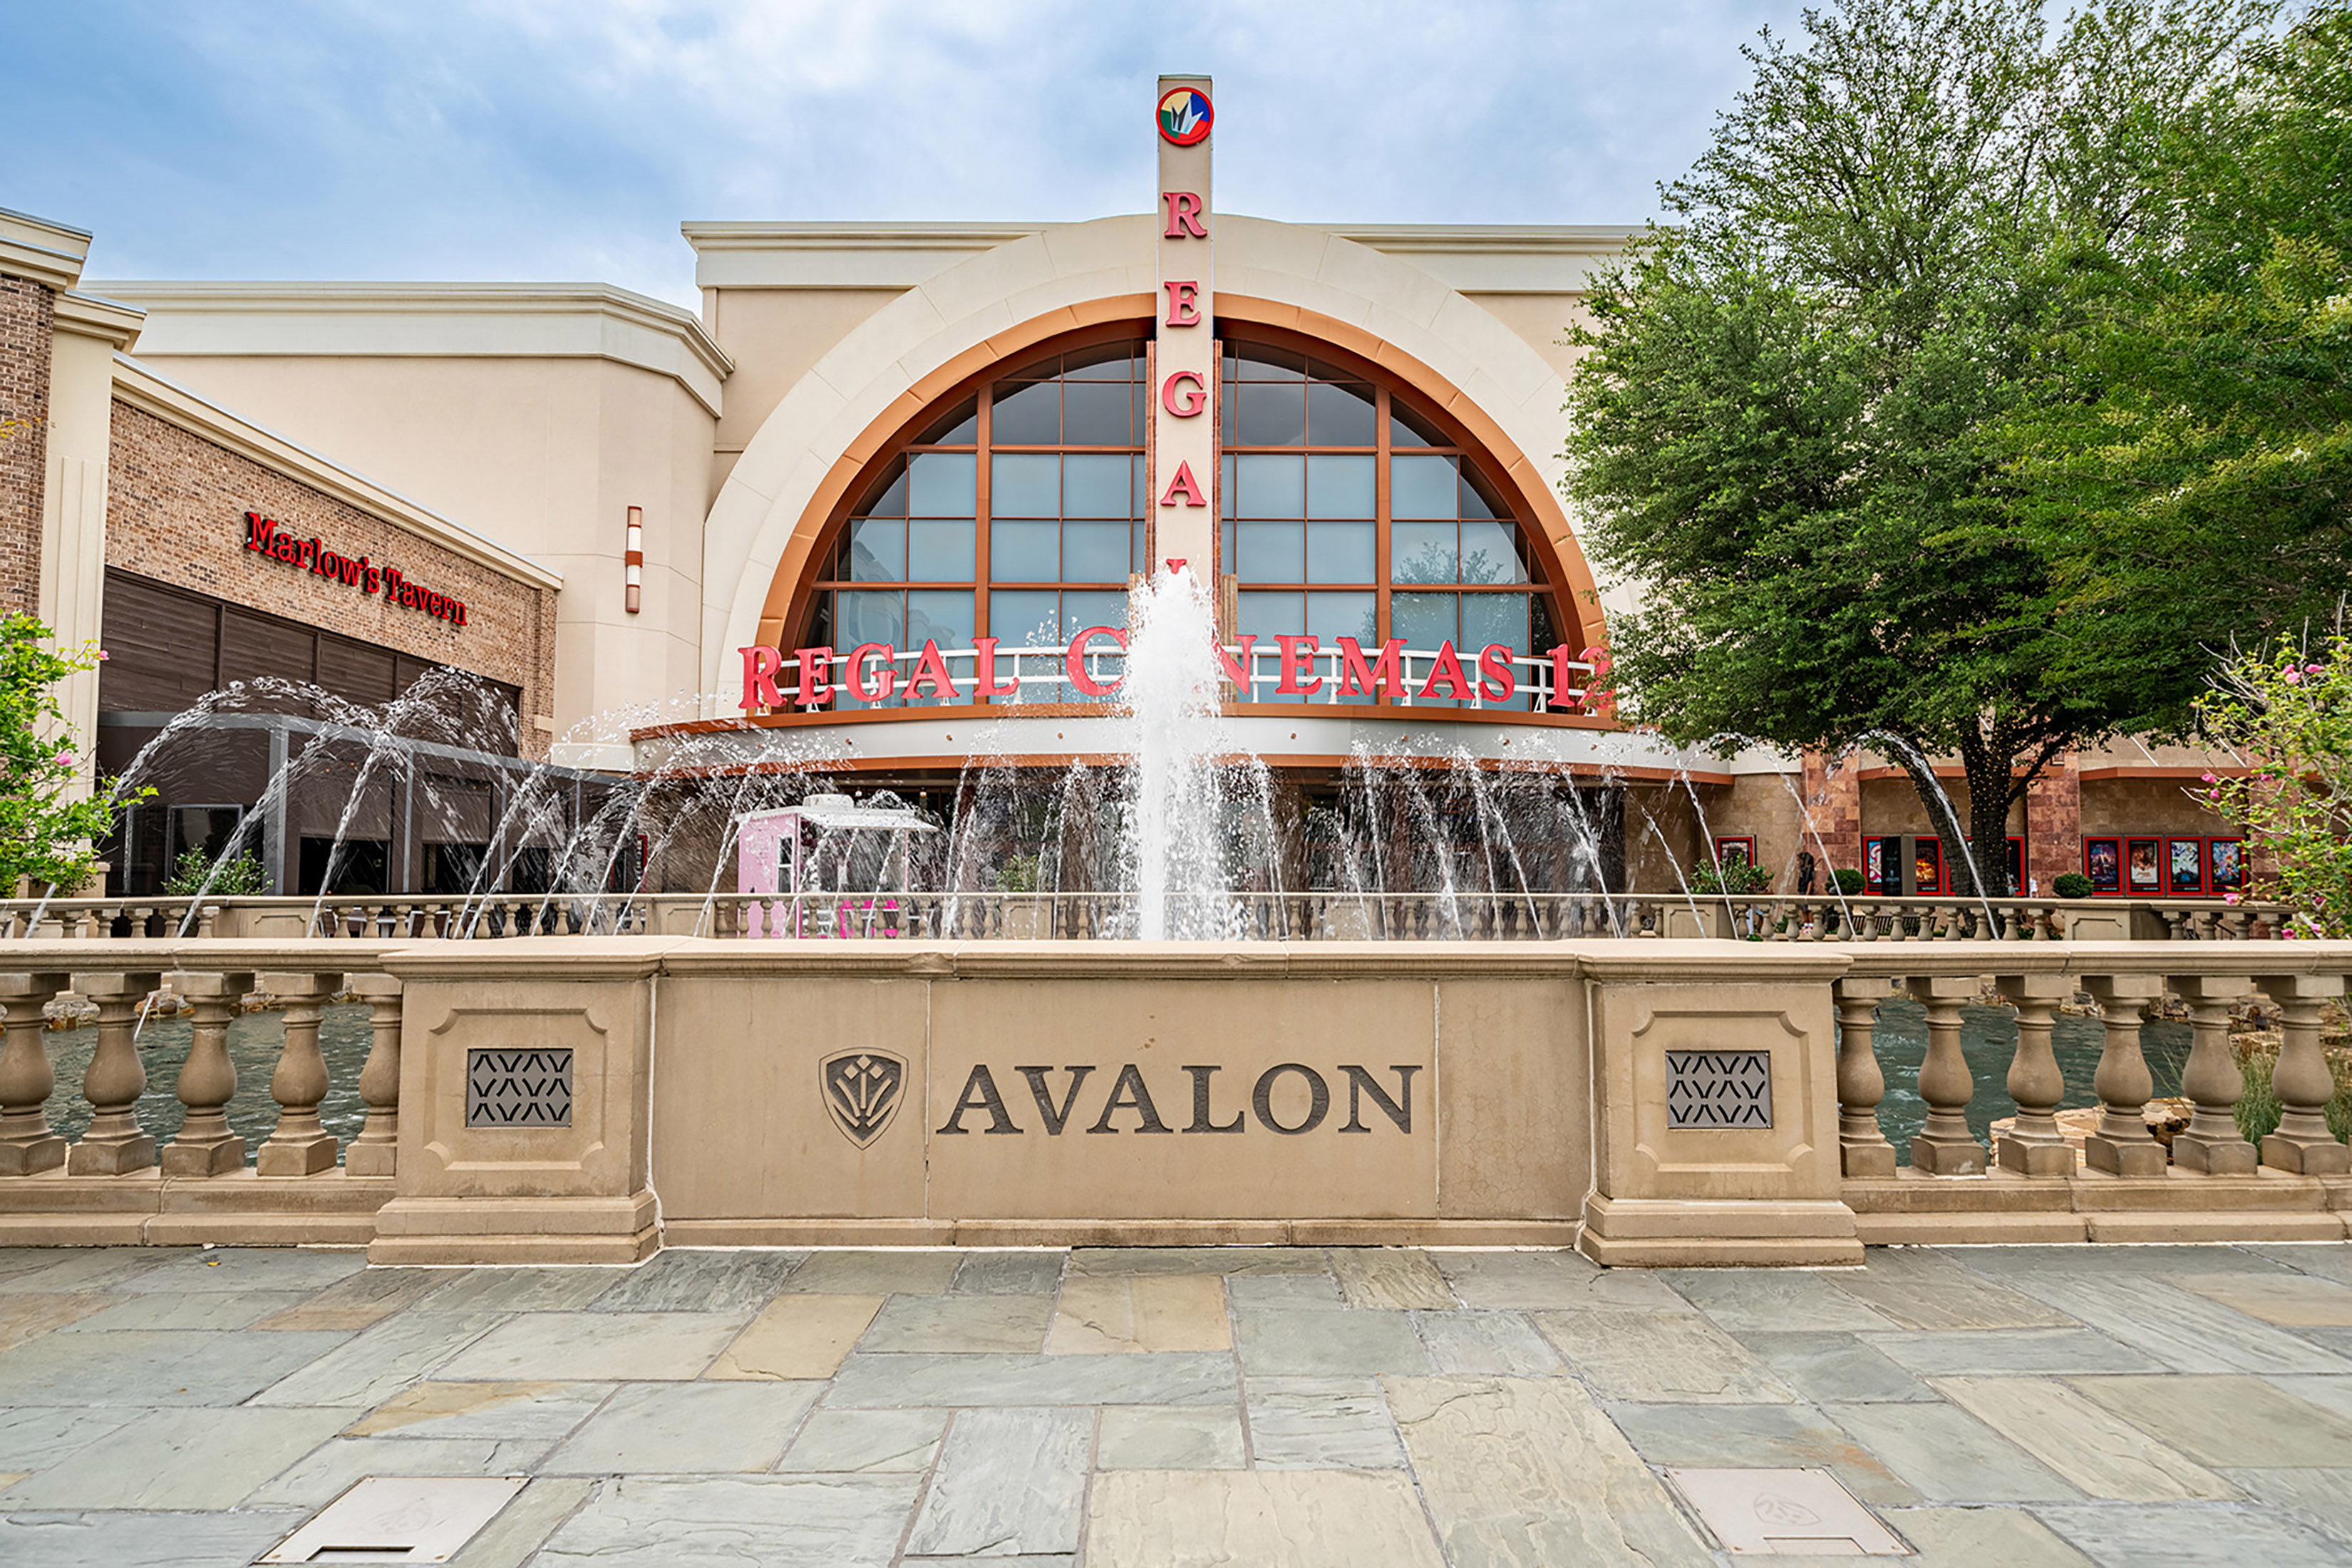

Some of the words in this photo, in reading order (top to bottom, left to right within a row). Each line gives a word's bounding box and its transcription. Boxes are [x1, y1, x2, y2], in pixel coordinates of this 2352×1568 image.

[1162, 192, 1208, 575] REGA
[244, 512, 381, 594] Marlow's
[384, 567, 468, 626] Tavern
[738, 636, 1021, 710] REGAL
[1066, 625, 1515, 703] CNEMAS
[1545, 643, 1613, 710] 12
[936, 1063, 1424, 1136] AVALON
